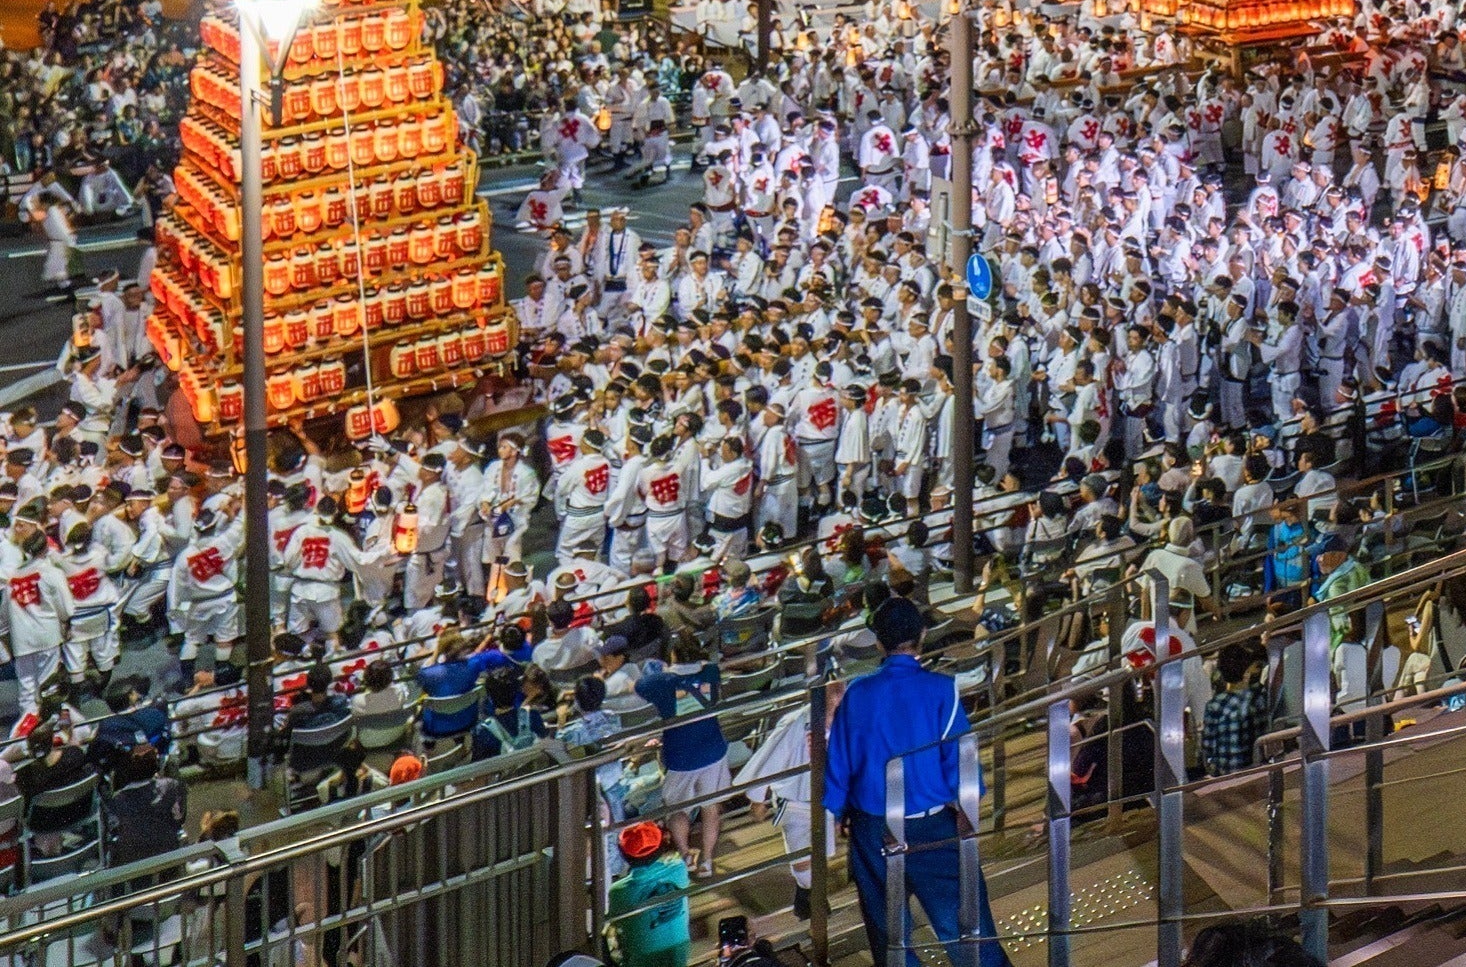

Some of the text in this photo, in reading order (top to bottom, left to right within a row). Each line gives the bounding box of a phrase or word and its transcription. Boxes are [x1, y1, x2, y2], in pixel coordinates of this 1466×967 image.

[584, 464, 609, 495] 西
[651, 473, 680, 505] 西
[187, 547, 224, 582] 西
[302, 537, 330, 570] 西
[10, 572, 41, 608] 西
